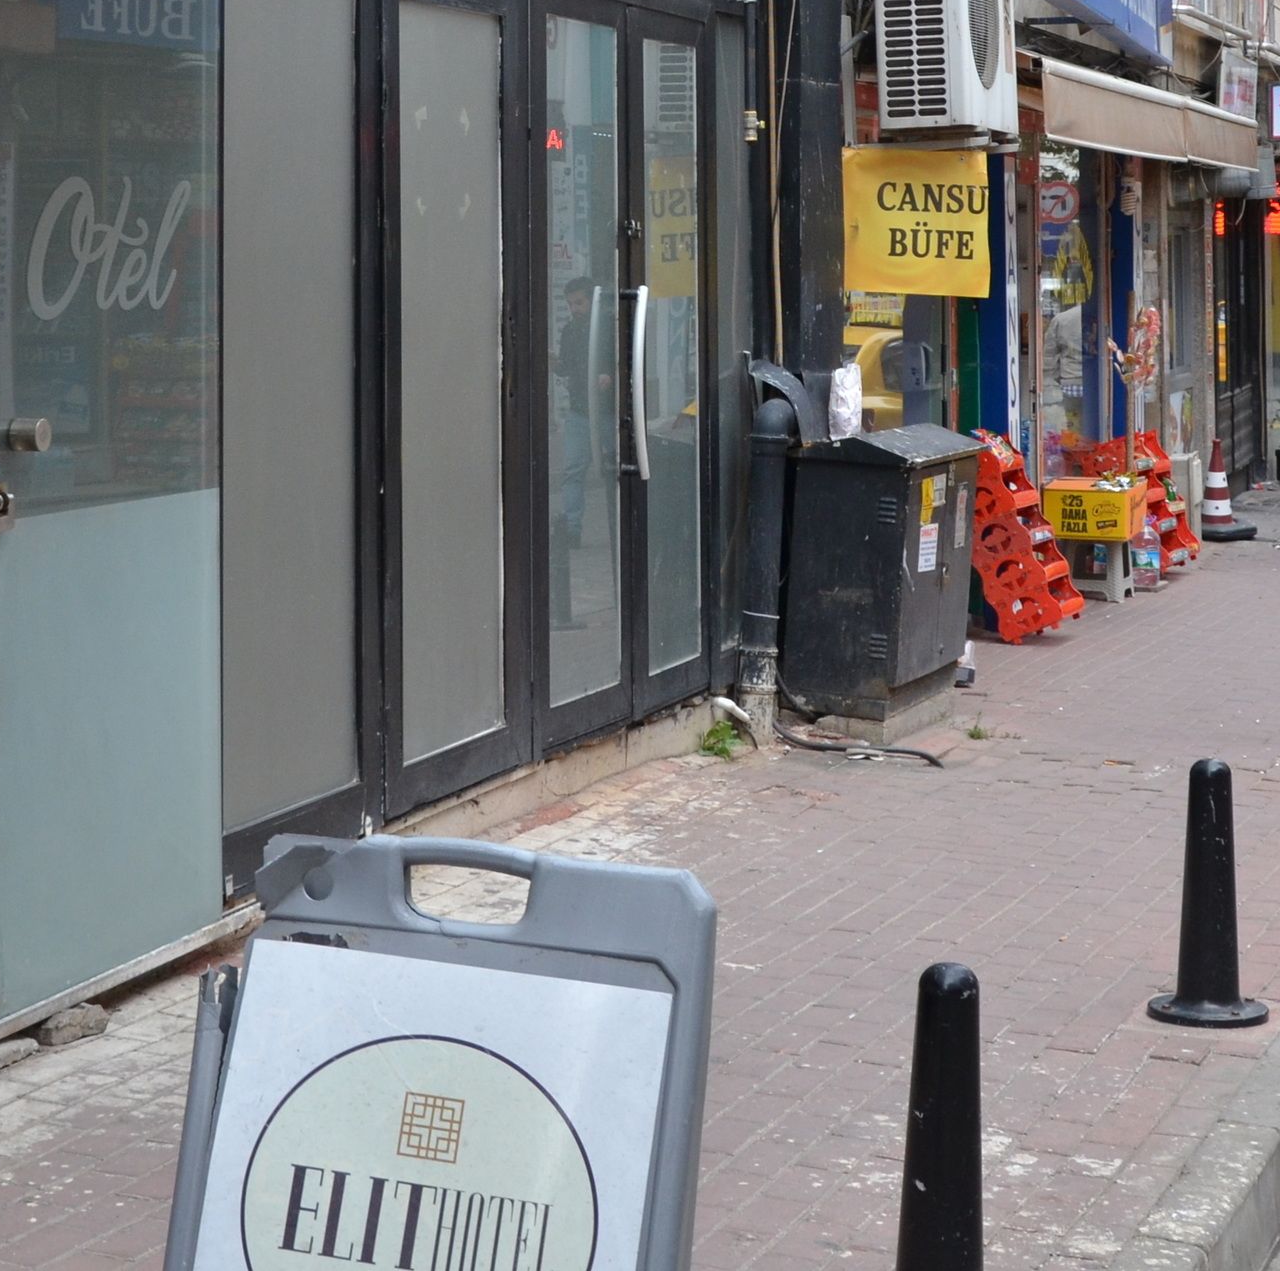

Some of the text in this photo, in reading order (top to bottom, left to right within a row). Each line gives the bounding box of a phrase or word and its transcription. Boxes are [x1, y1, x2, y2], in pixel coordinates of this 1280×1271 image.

[876, 181, 989, 215] CANSU
[888, 220, 975, 261] BÜFE
[1061, 508, 1088, 521] DAHA
[1061, 520, 1089, 534] FAZLA
[277, 1162, 438, 1271] ELIT
